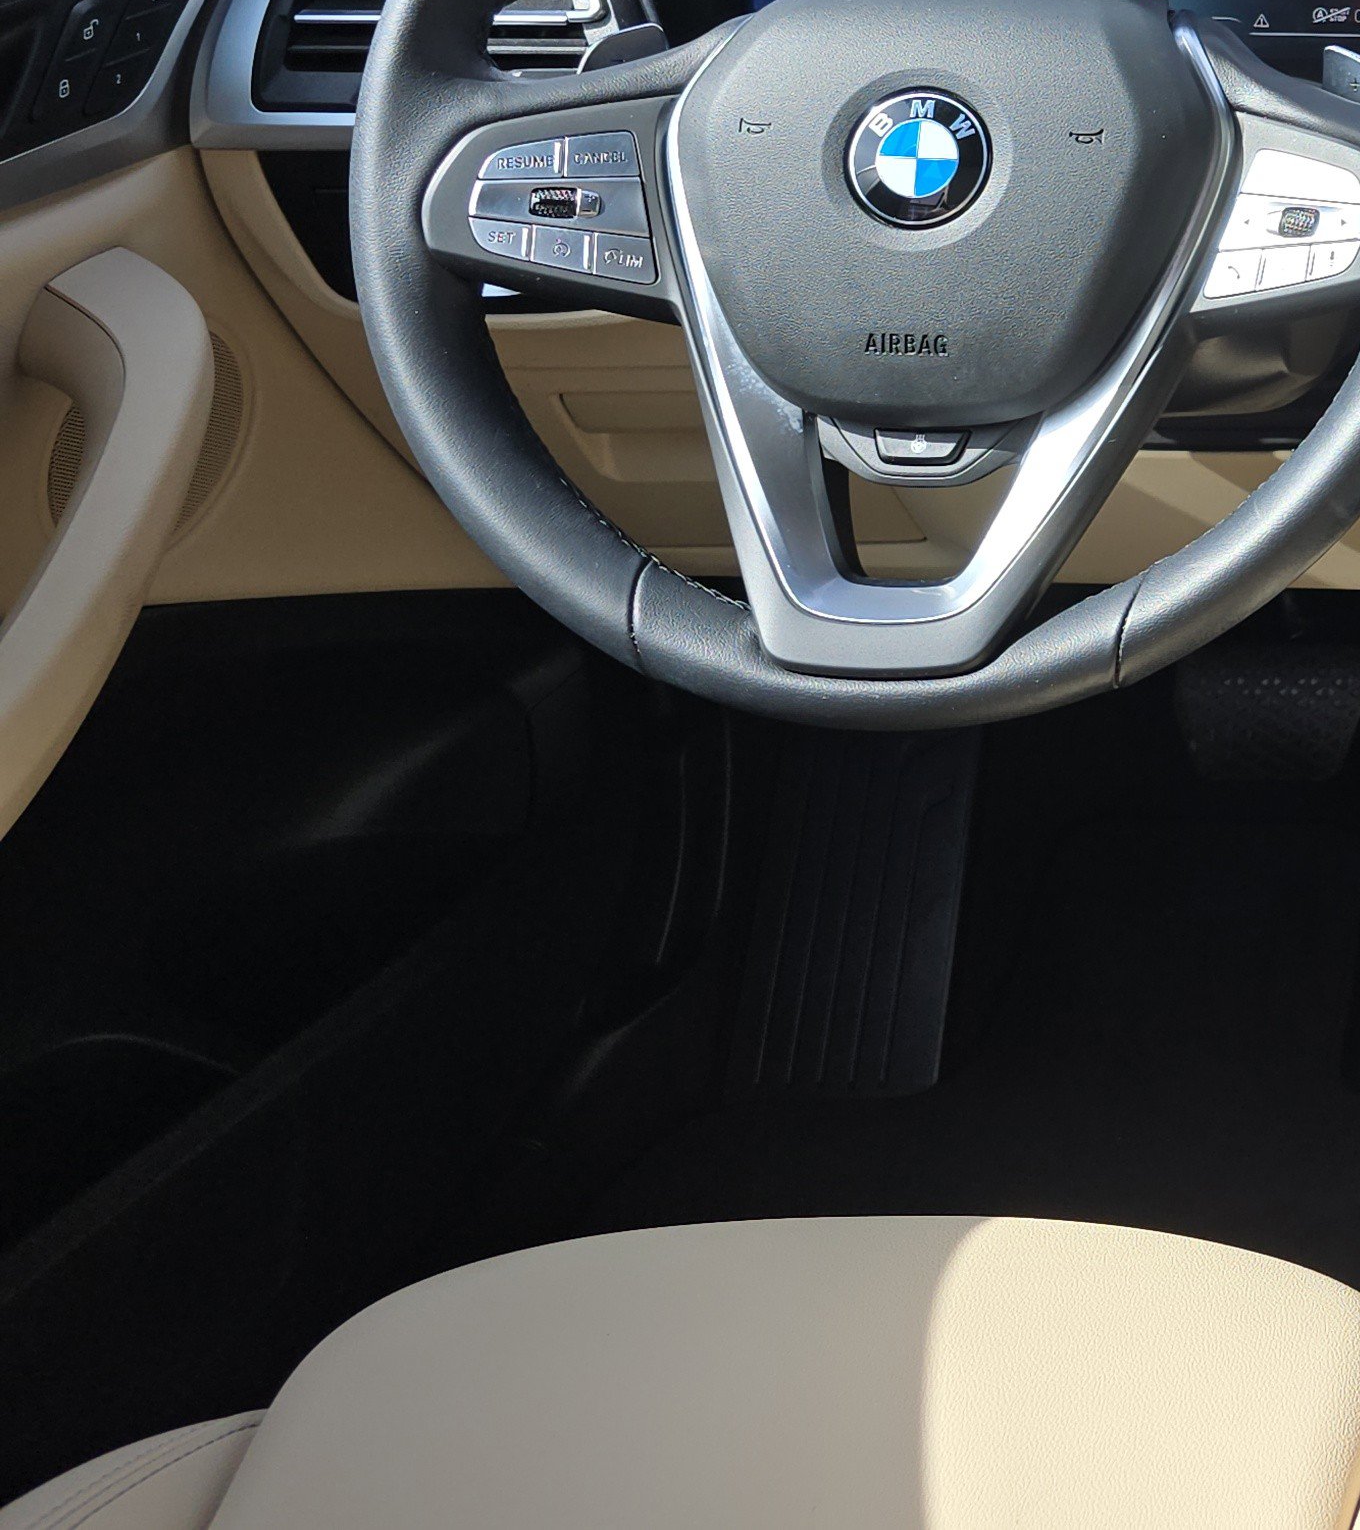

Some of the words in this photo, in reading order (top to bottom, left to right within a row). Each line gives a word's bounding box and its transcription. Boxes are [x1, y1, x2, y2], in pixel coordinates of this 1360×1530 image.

[115, 74, 122, 85] 2
[868, 99, 976, 140] BMW
[497, 154, 554, 170] RESUME
[573, 151, 629, 165] CANCEL
[487, 231, 516, 245] SET
[618, 253, 645, 269] LIM
[863, 331, 951, 358] AIRBAG
